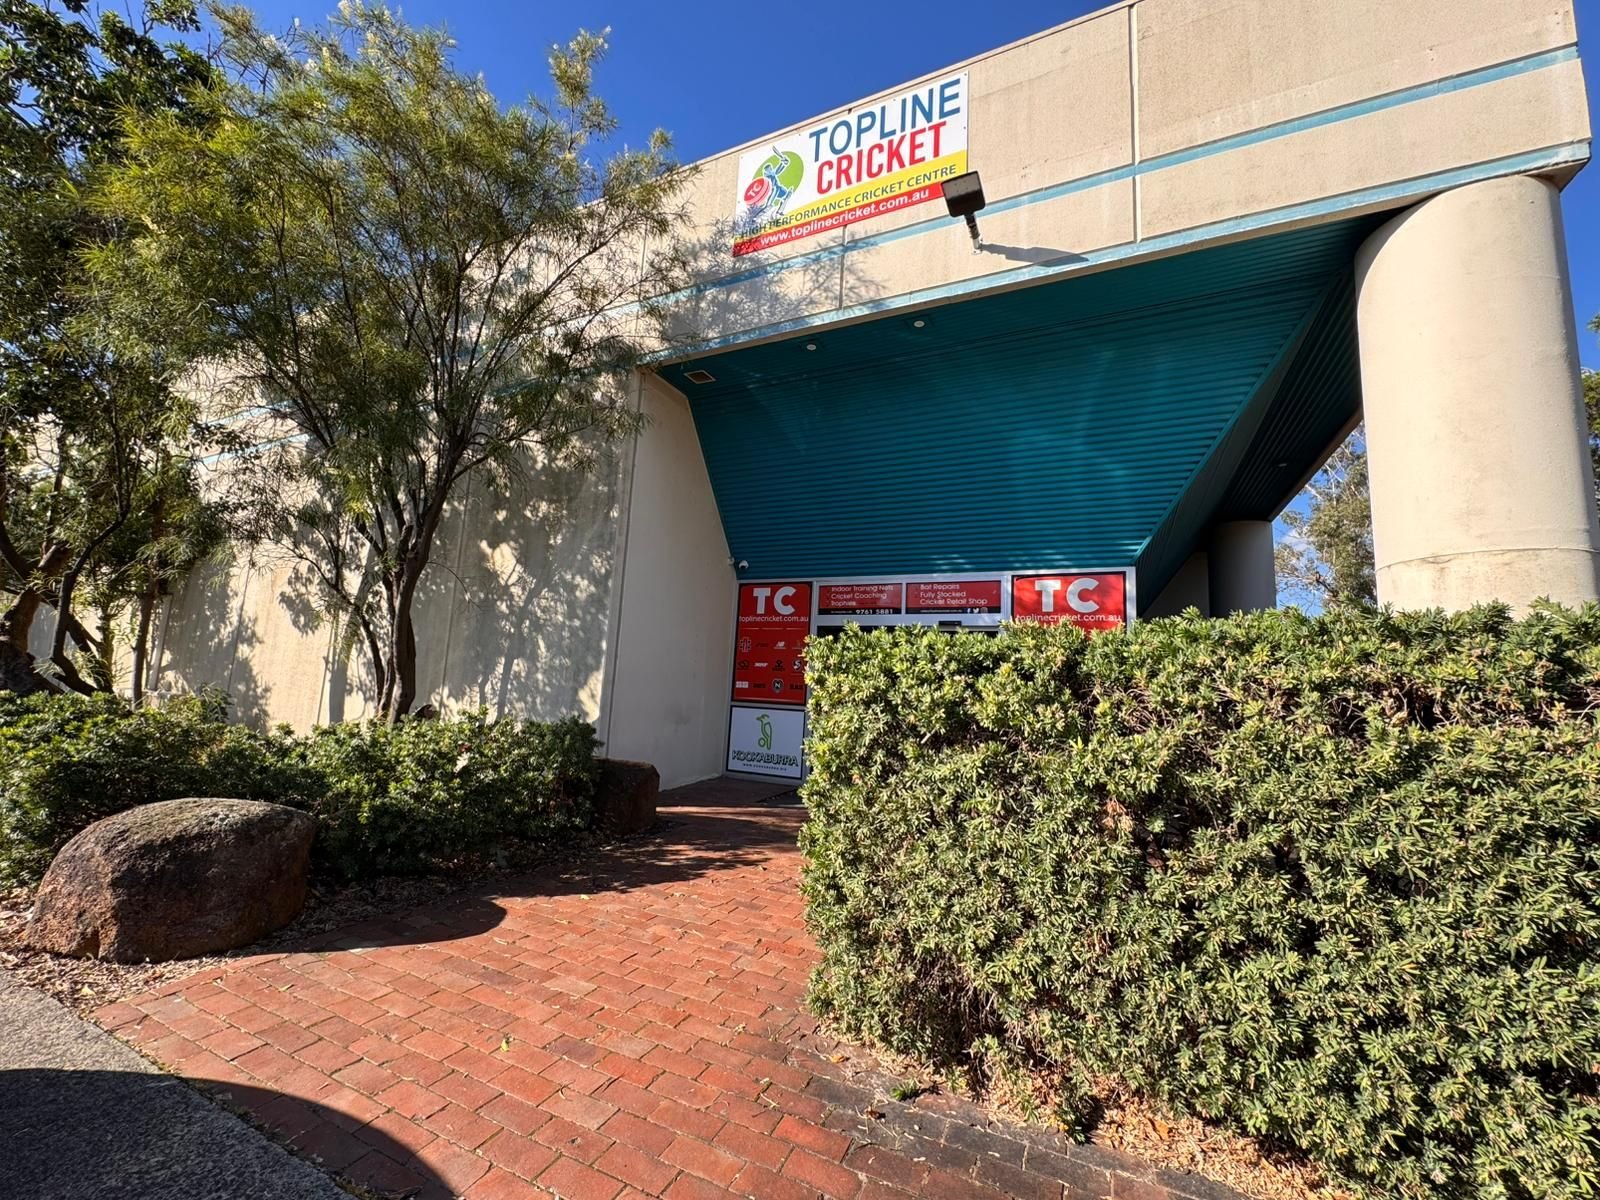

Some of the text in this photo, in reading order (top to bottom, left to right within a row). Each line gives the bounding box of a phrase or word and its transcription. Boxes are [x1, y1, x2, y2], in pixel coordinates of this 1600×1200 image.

[809, 78, 961, 163] TOPLINE
[816, 121, 947, 195] CRICKET
[740, 164, 957, 239] HIGH PERFORMANCE CRICKET CENTRE
[747, 183, 763, 199] TC
[760, 189, 929, 246] www.toplinecricket.com.au
[753, 586, 797, 615] TC
[937, 591, 966, 599] Stocked
[1034, 577, 1100, 613] TC
[732, 749, 799, 767] KOOKABURRA
